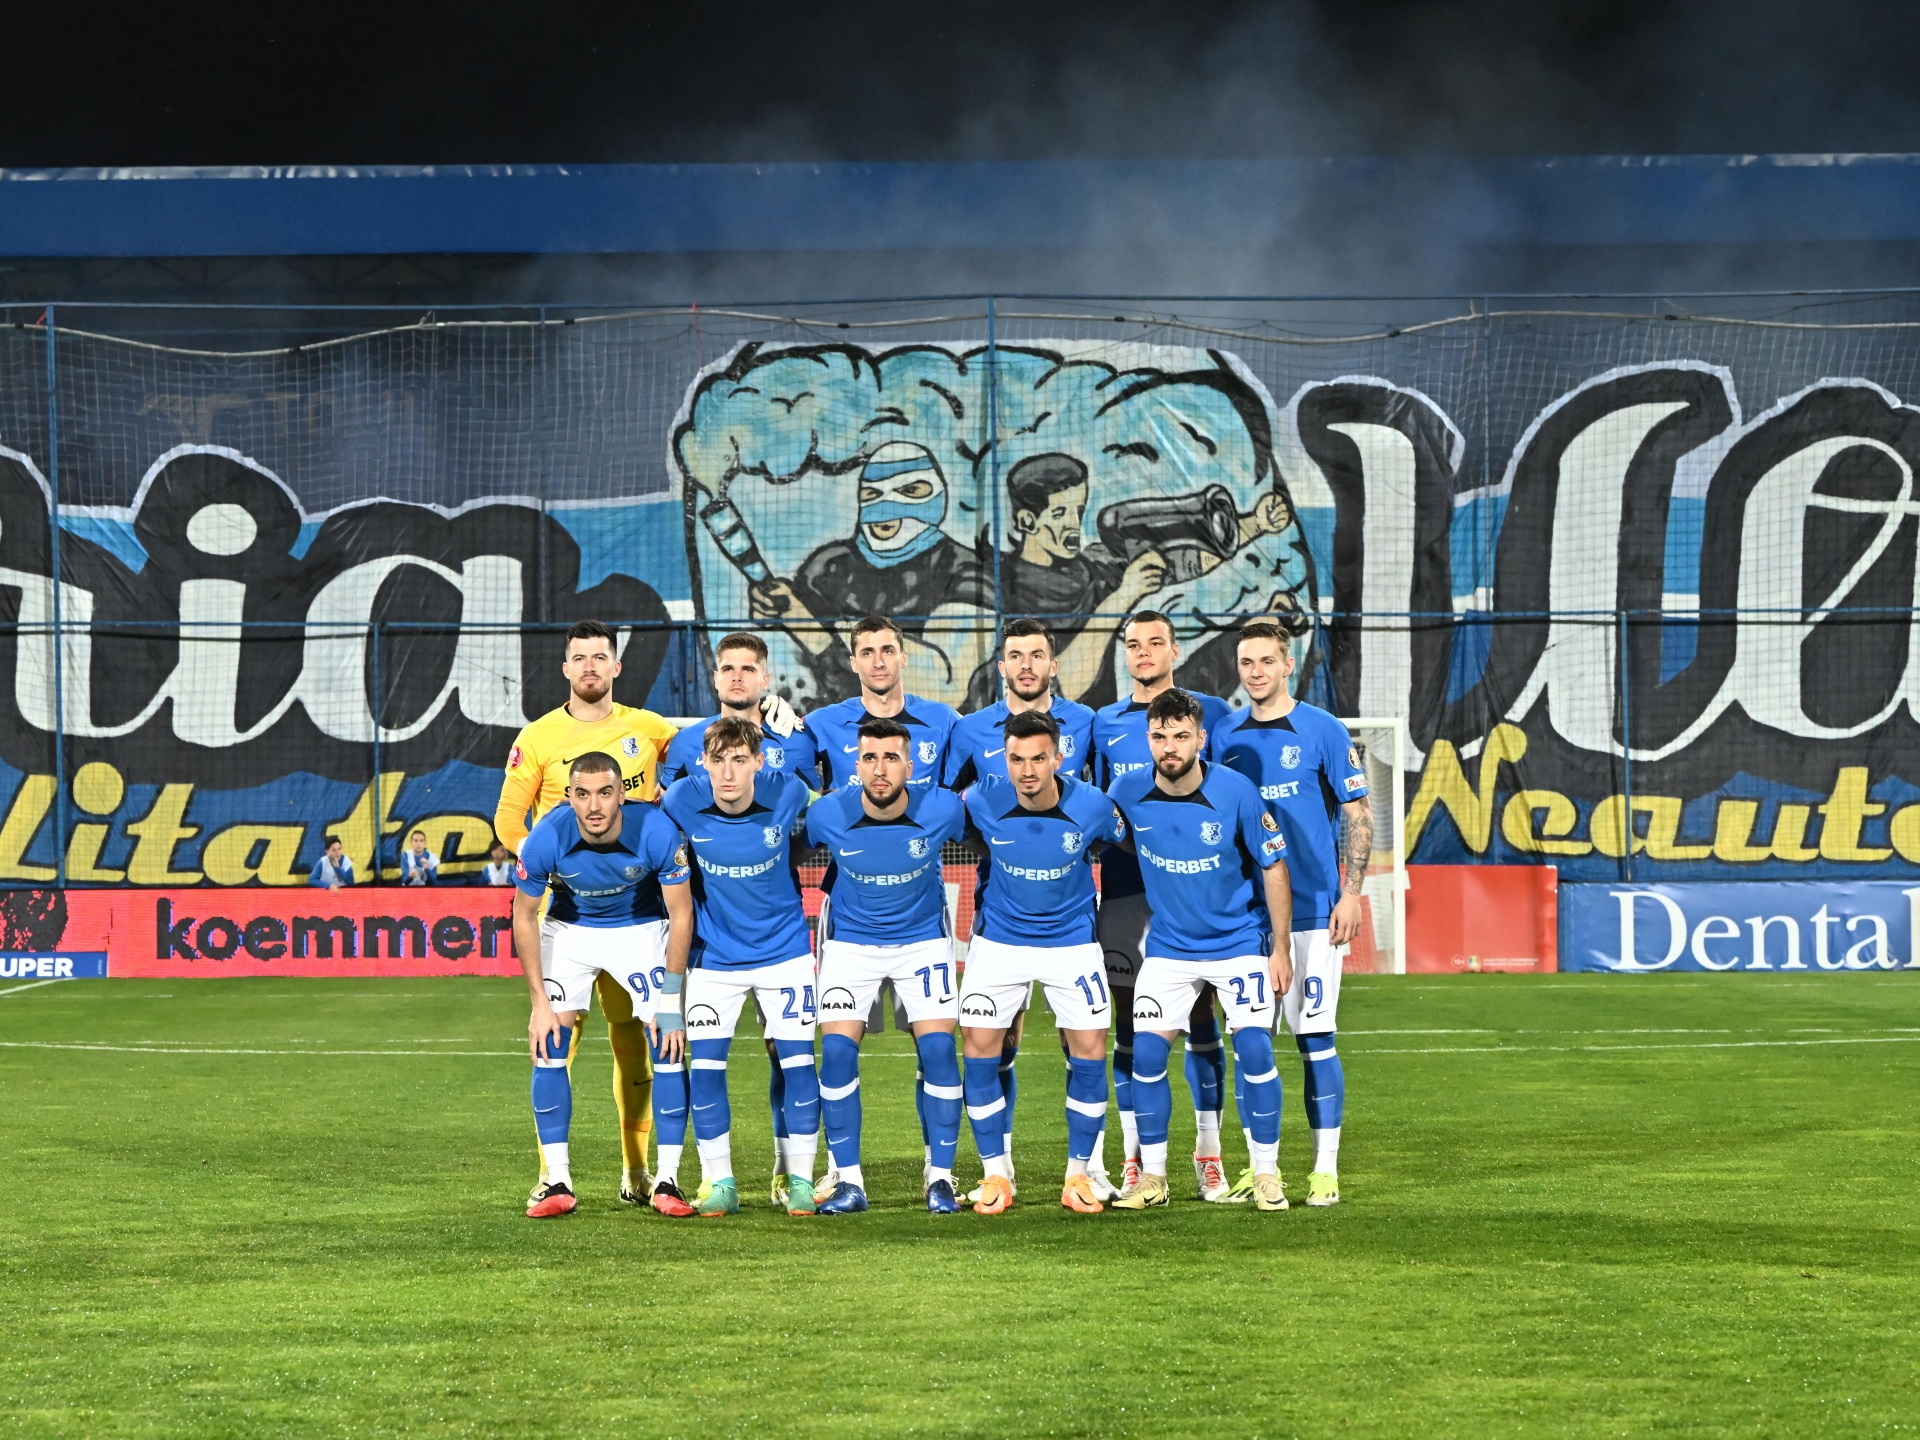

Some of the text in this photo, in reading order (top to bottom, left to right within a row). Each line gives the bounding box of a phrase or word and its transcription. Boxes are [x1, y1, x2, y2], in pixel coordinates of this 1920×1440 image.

[696, 851, 782, 878] SUPERBET
[1140, 844, 1220, 874] SUPERBET
[1609, 887, 1920, 972] Dental
[915, 963, 950, 997] 77
[1074, 972, 1107, 1005] 11
[1229, 972, 1264, 1004] 27
[1304, 976, 1323, 1009] 9
[781, 985, 816, 1018] 24
[822, 1001, 853, 1010] MAN
[961, 1006, 994, 1017] MAN
[687, 1018, 719, 1027] MAN
